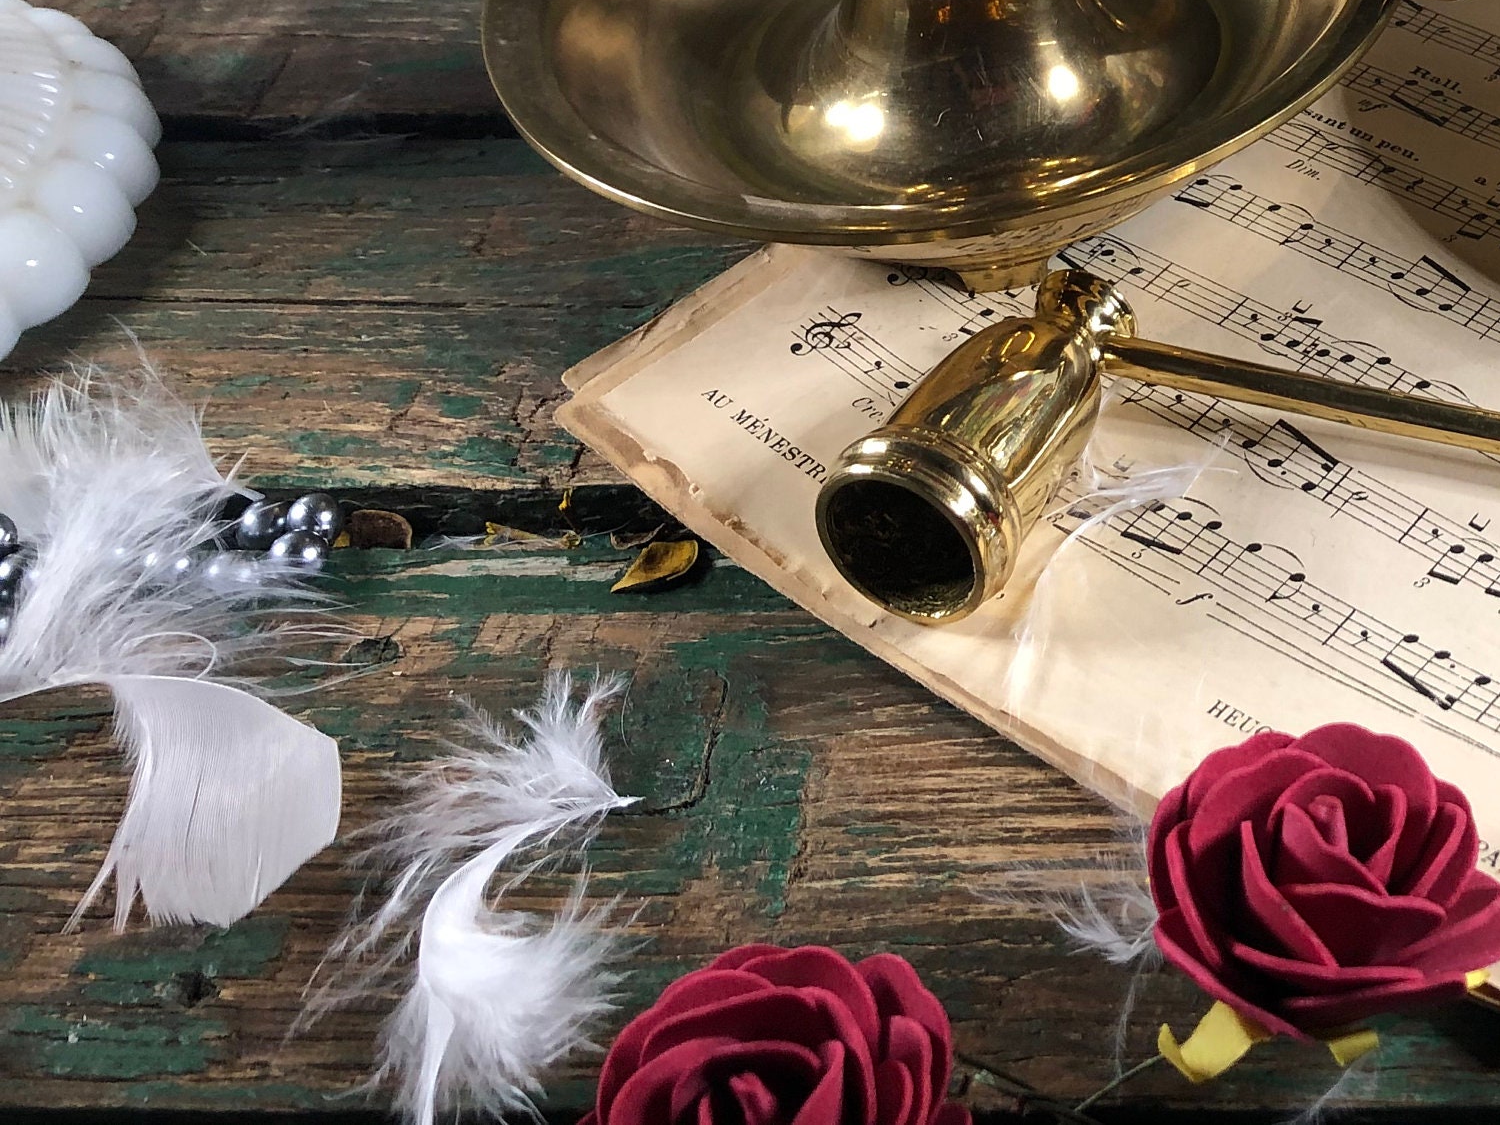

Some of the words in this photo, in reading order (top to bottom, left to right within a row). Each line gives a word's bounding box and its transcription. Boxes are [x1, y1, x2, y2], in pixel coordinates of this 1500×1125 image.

[1408, 65, 1462, 94] Rall.
[1302, 108, 1347, 130] sant
[1350, 127, 1374, 143] un
[1375, 134, 1420, 162] peu.
[1285, 159, 1320, 181] Dim.
[1474, 176, 1487, 186] a
[701, 389, 734, 409] AU
[1207, 699, 1273, 735] HEU
